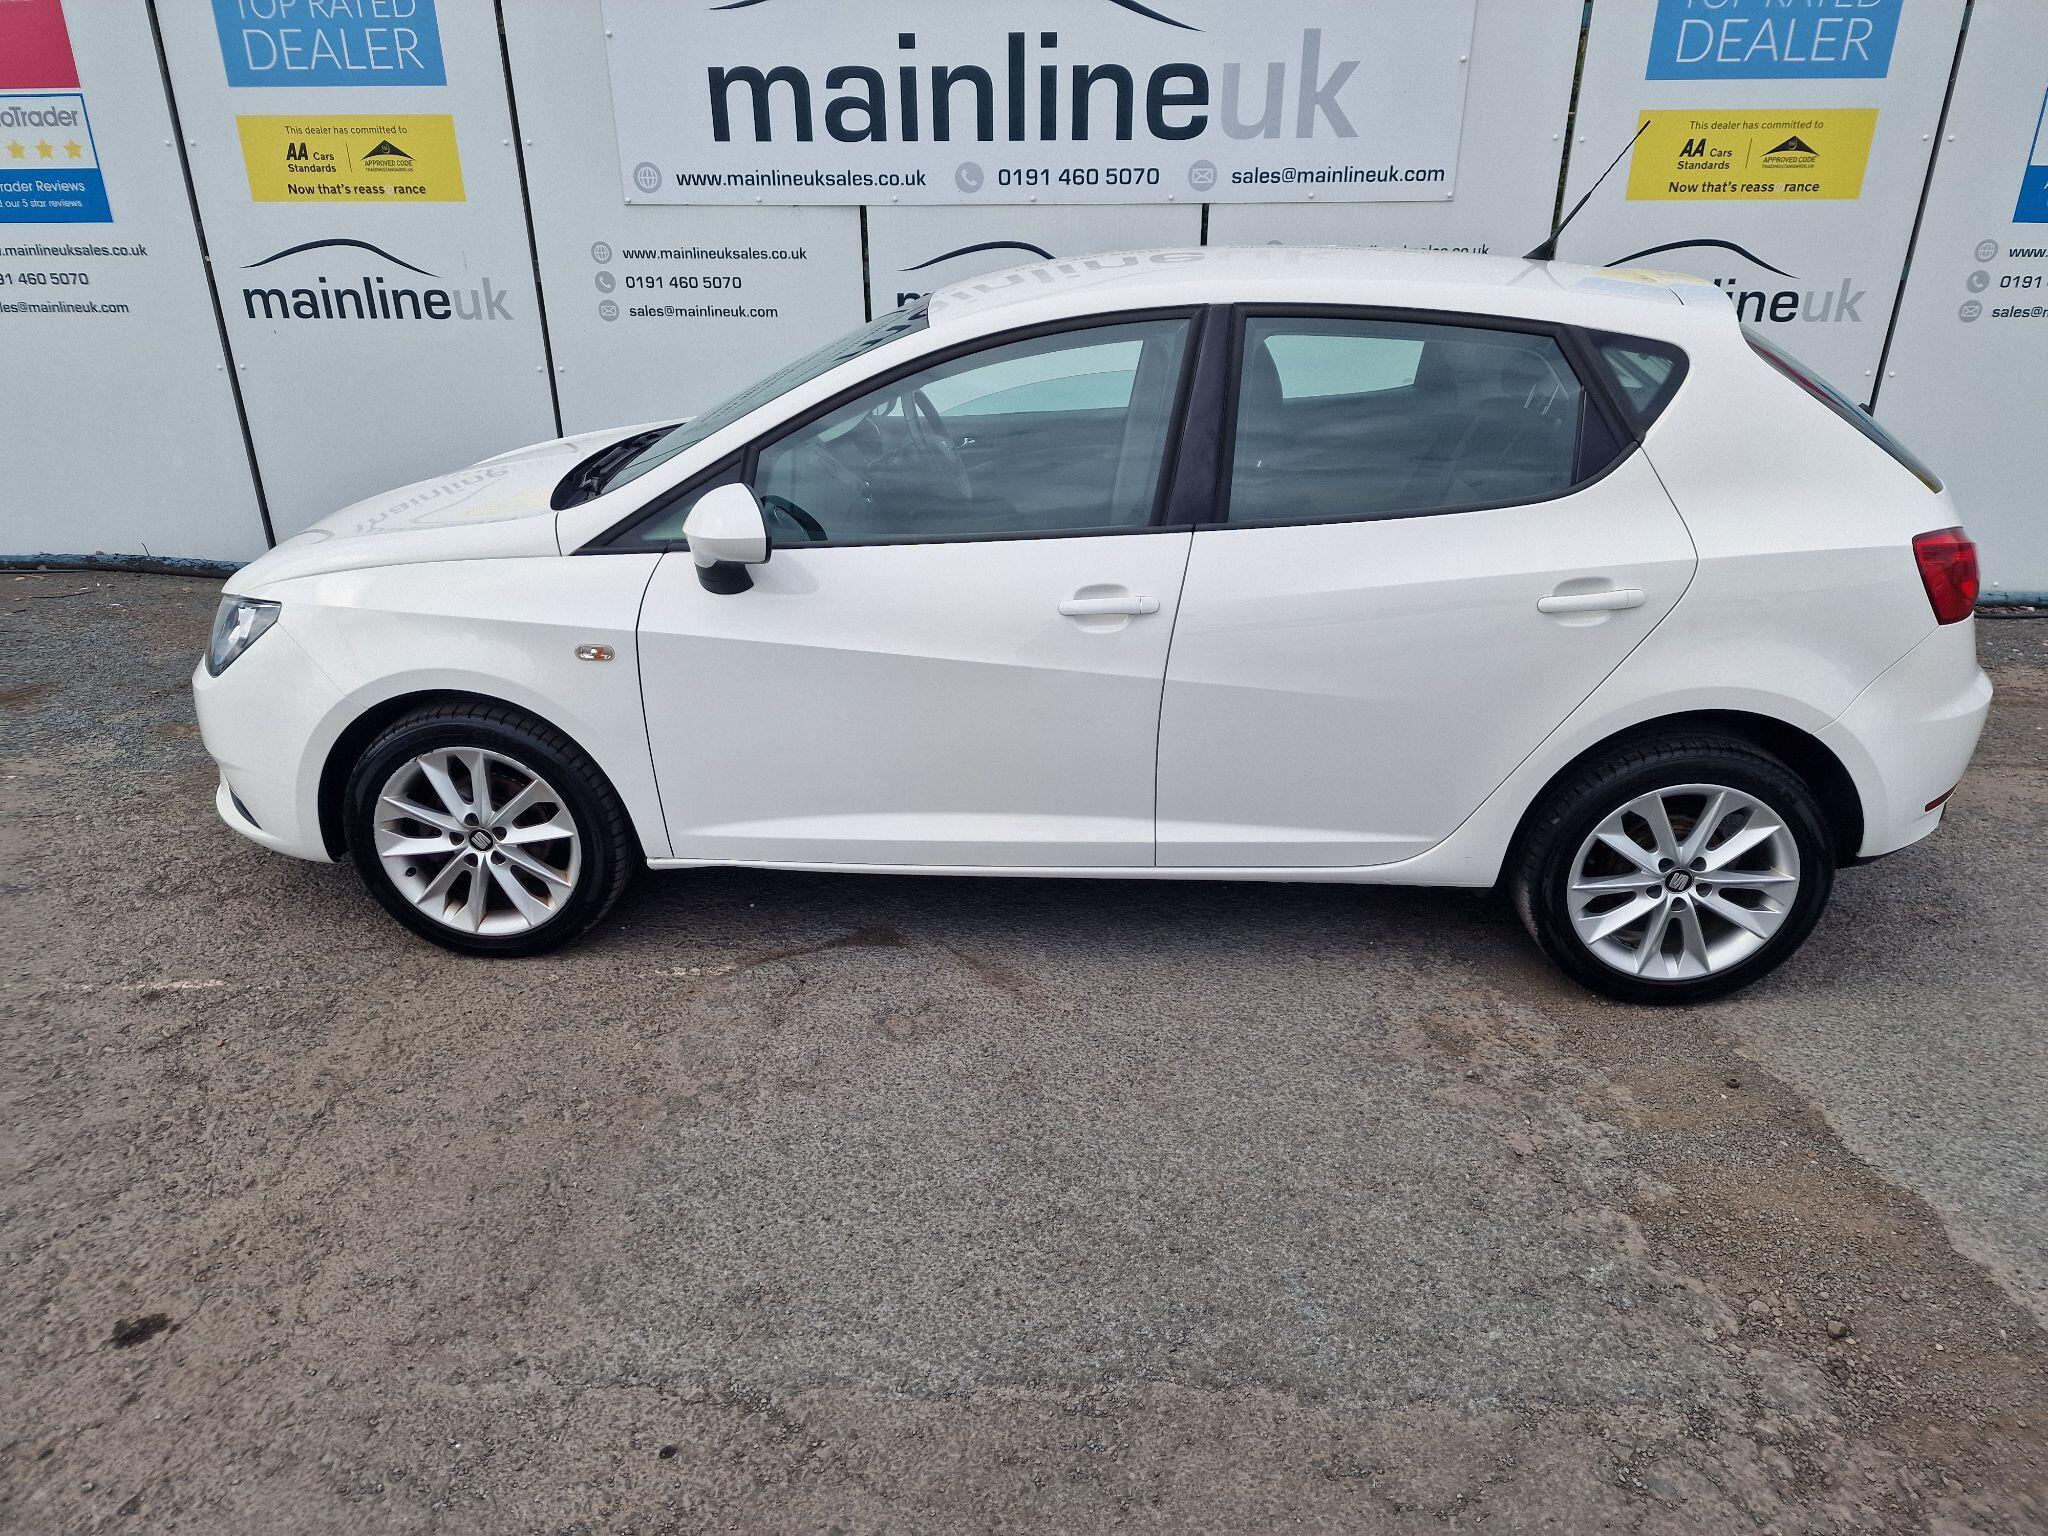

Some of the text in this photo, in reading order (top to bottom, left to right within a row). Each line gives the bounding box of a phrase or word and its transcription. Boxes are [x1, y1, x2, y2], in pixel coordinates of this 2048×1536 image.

[1676, 17, 1873, 63] DEALER
[242, 28, 425, 70] DEALER
[707, 28, 1360, 142] mainlineuk
[0, 106, 78, 127] oTrader
[284, 125, 408, 135] This dealer has committed to
[1690, 119, 1824, 130] This dealer has committed to
[286, 142, 335, 161] AA Cars
[1679, 138, 1733, 158] AA Cars
[288, 163, 337, 173] Standards
[1677, 160, 1730, 170] Standards
[676, 169, 927, 186] www.mainlineuksales.co.uk
[998, 167, 1160, 186] 0191 460 5070
[1231, 165, 1446, 184] sales@mainlineuk.com
[35, 180, 86, 192] Reviews
[288, 183, 427, 195] Now that's reassrance
[1668, 181, 1820, 193] Now that's reassrance
[4, 200, 20, 208] our
[22, 198, 29, 208] 5
[30, 199, 46, 208] star
[48, 199, 83, 208] reviews
[623, 246, 807, 260] www.mainlineuksales.co.uk
[18, 272, 47, 285] 460
[49, 272, 89, 285] 5070
[626, 276, 742, 289] 0191 460 5070
[2000, 275, 2042, 288] 0191
[242, 276, 514, 321] mainlineuk
[629, 305, 779, 318] sales@mainlineuk.com
